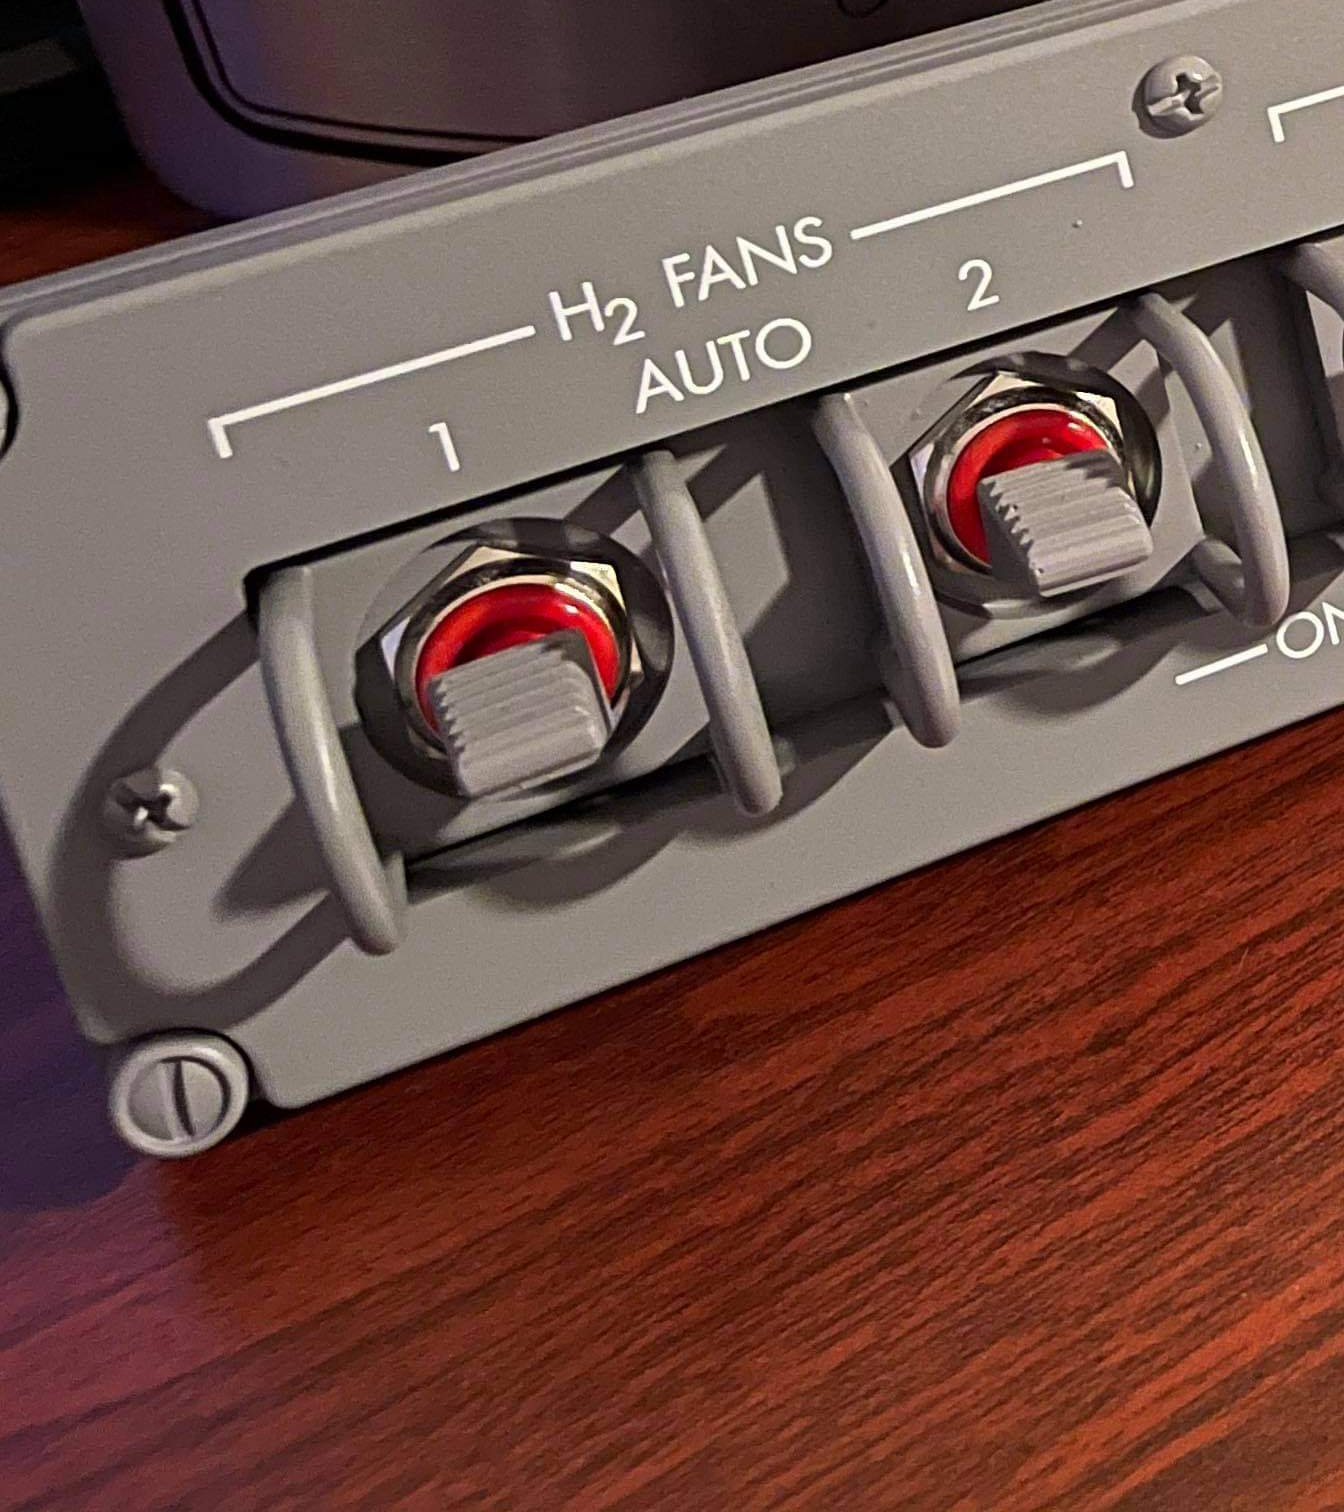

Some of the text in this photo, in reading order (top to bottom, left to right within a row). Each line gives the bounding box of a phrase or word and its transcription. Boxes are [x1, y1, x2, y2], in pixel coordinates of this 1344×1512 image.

[660, 217, 833, 309] FANS
[428, 259, 1000, 472] 1 AUTO 2
